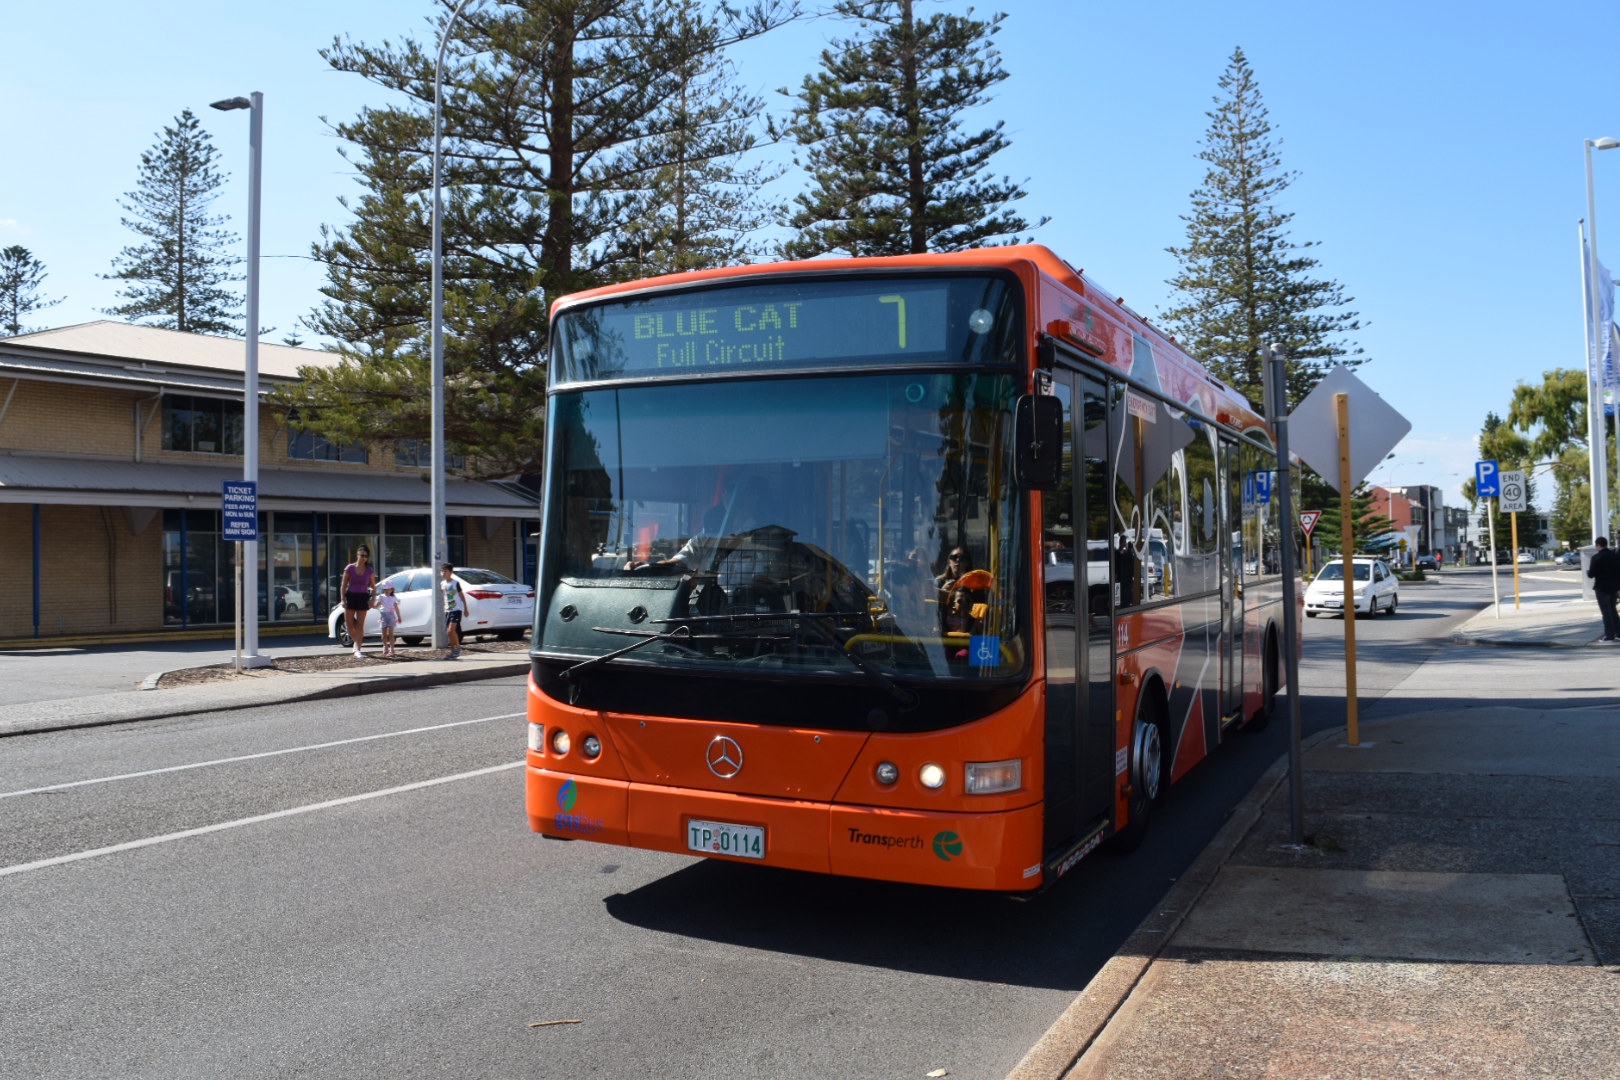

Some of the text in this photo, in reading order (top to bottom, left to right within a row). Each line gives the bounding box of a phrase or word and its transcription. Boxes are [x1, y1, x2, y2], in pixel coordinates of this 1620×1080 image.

[634, 302, 802, 339] BLUE CAT
[878, 295, 906, 348] 7
[657, 335, 785, 368] Full Circuit
[1479, 463, 1494, 483] P
[1503, 474, 1520, 482] END
[224, 494, 255, 502] PARKING
[227, 486, 252, 494] TICKET
[1505, 487, 1519, 497] 40
[1118, 623, 1129, 647] 114
[691, 827, 760, 854] TP 0114
[848, 827, 925, 850] Transperth
